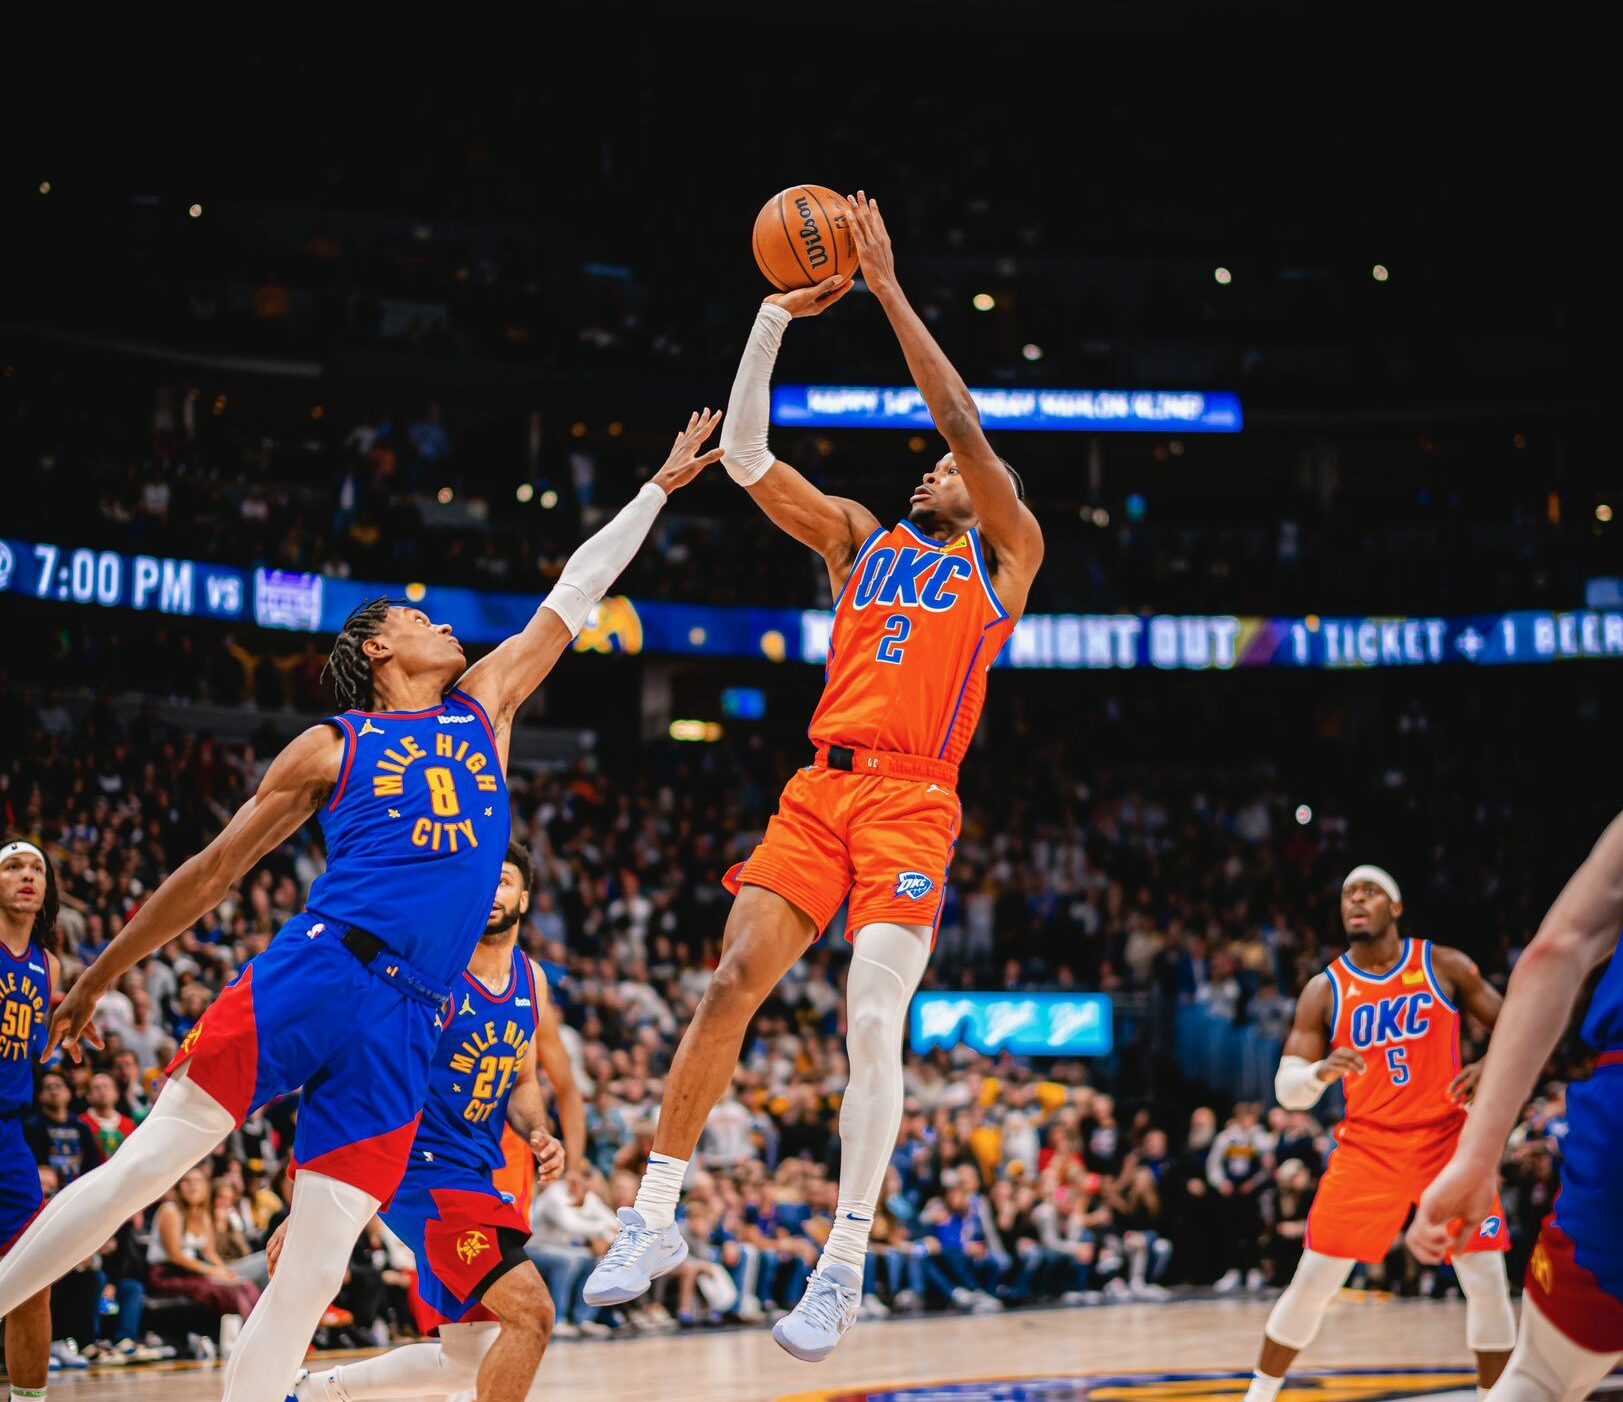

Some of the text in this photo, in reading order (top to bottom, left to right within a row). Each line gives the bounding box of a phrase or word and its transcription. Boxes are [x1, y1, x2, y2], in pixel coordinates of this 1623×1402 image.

[795, 196, 828, 269] Wilson
[34, 543, 121, 606] 7:00
[132, 555, 196, 616] PM
[853, 547, 973, 613] OKC
[876, 614, 911, 665] 2
[1010, 614, 1140, 667] NIGHT
[1148, 616, 1238, 669] OUT
[1290, 622, 1309, 665] 1
[1323, 617, 1447, 667] TICKET
[1503, 617, 1516, 657] 1
[372, 732, 498, 798] MILE HIGH
[424, 766, 461, 818] 8
[411, 816, 479, 853] CITY
[1, 999, 32, 1040] 50
[1350, 992, 1434, 1051] OKC
[450, 1020, 499, 1074] MILE
[1385, 1046, 1411, 1086] 5
[472, 1056, 517, 1100] 27
